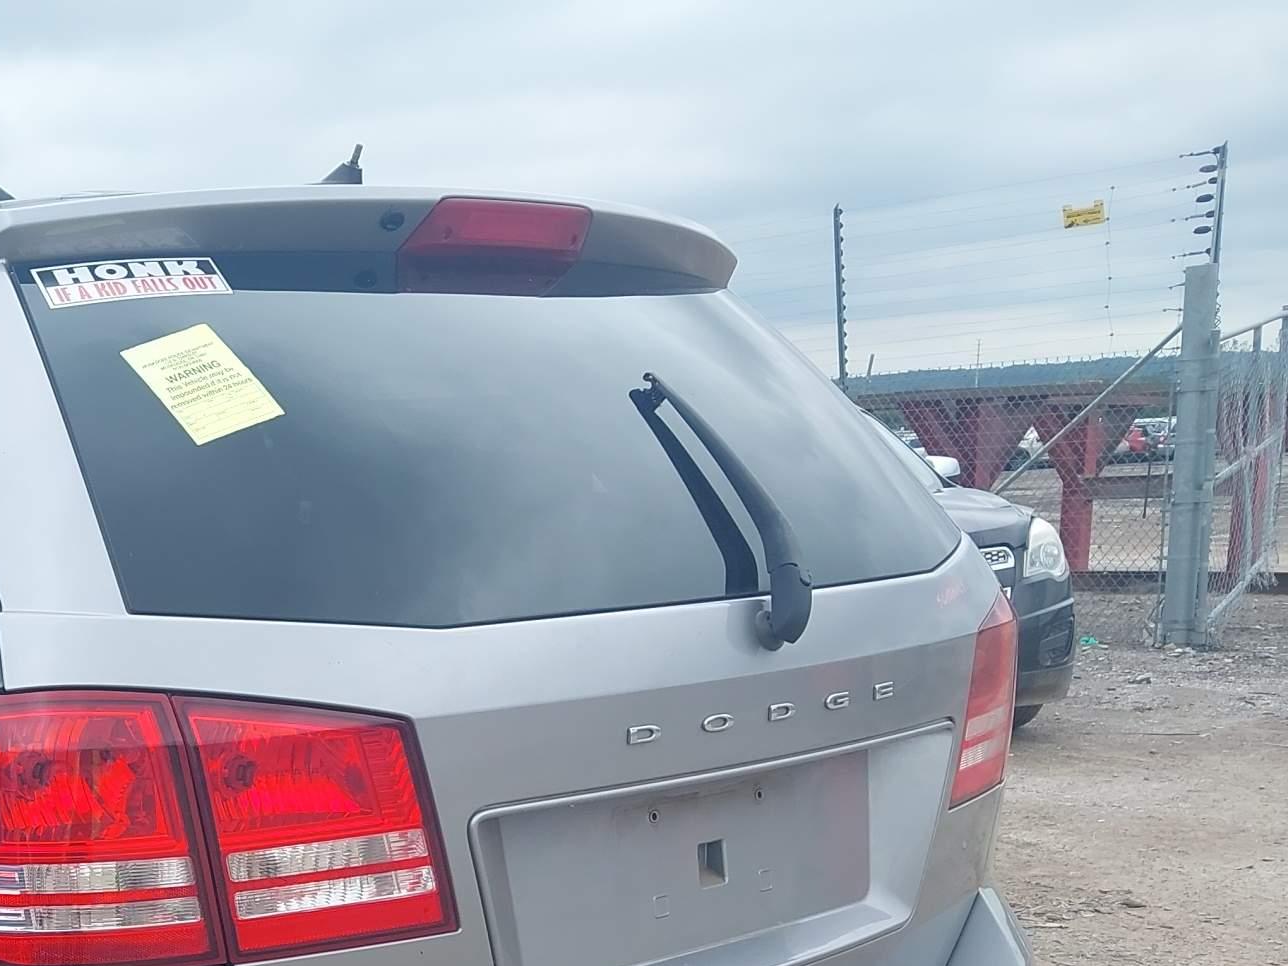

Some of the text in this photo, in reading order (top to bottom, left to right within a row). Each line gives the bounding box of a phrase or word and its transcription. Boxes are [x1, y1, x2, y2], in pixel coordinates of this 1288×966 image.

[52, 260, 205, 286] HONK
[54, 276, 218, 303] IF A KID FALLS OUT
[165, 360, 221, 383] WARNING
[626, 681, 895, 746] DODGE
